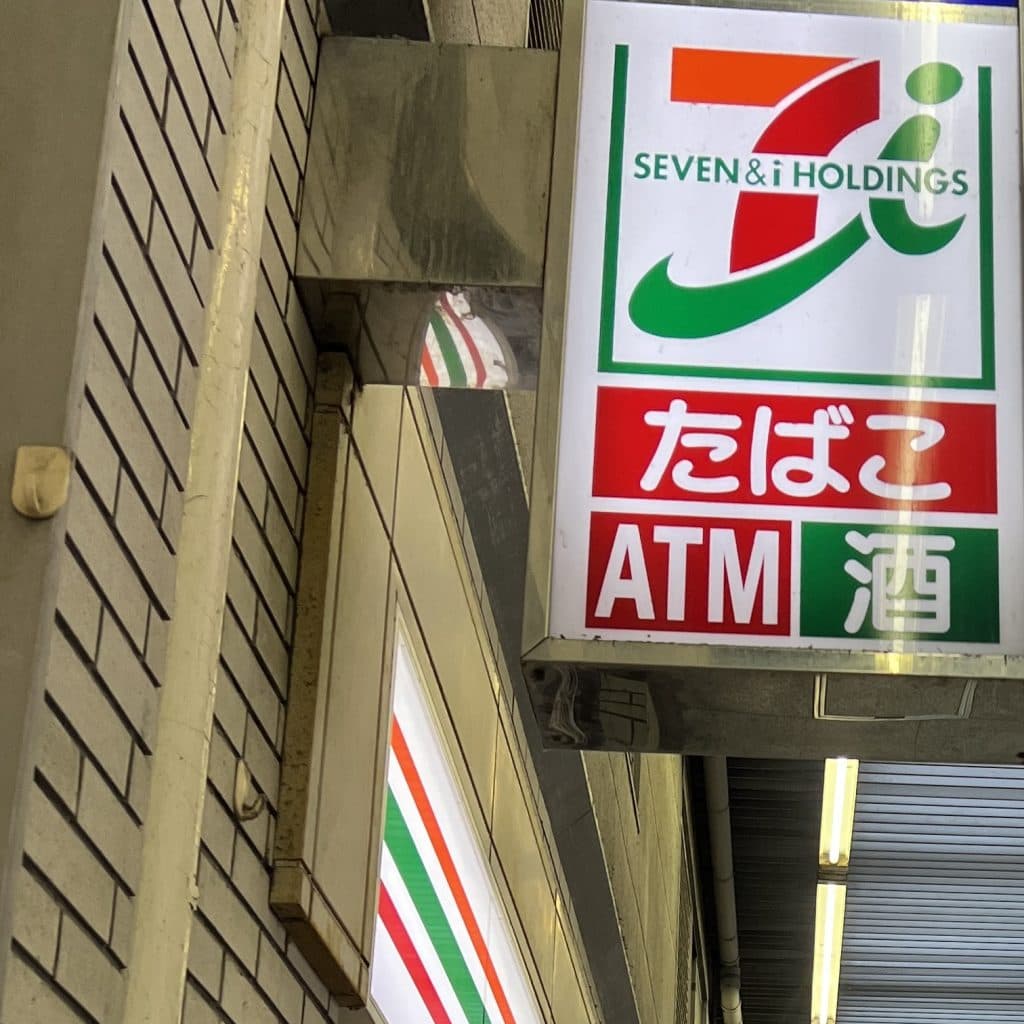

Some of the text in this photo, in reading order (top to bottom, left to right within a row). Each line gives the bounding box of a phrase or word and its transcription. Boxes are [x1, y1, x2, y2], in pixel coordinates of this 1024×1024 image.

[793, 162, 969, 196] HOLDINGS
[639, 399, 951, 500] たばこ
[594, 523, 780, 625] ATM
[843, 529, 955, 634] 酒
